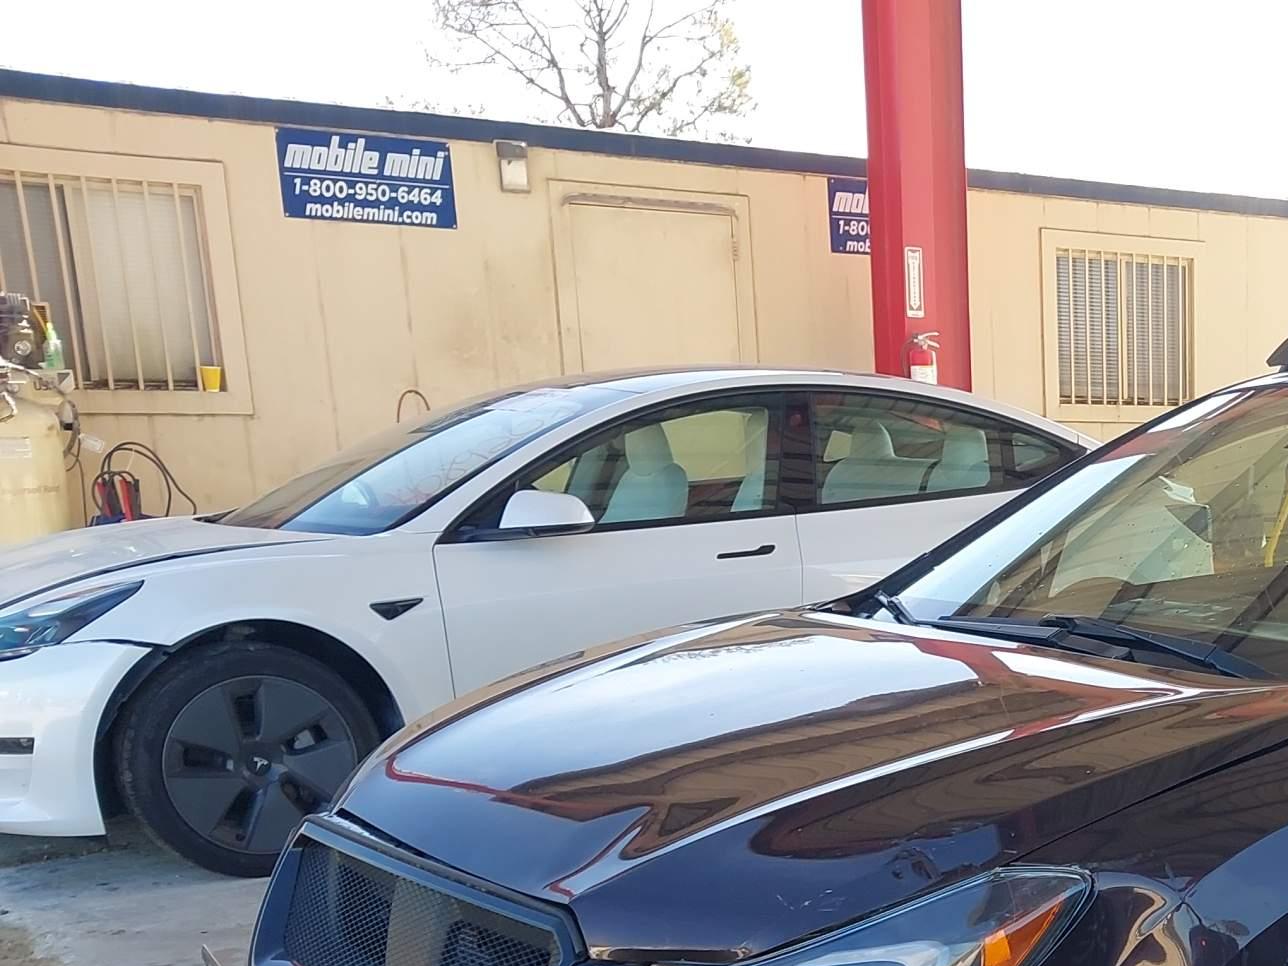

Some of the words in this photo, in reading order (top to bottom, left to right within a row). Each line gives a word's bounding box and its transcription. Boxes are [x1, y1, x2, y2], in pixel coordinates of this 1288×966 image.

[284, 135, 379, 174] mobile
[383, 148, 445, 181] mini
[293, 178, 443, 206] 1-800-950-6464
[304, 202, 438, 225] mobilemini.com
[838, 219, 870, 236] 1-80
